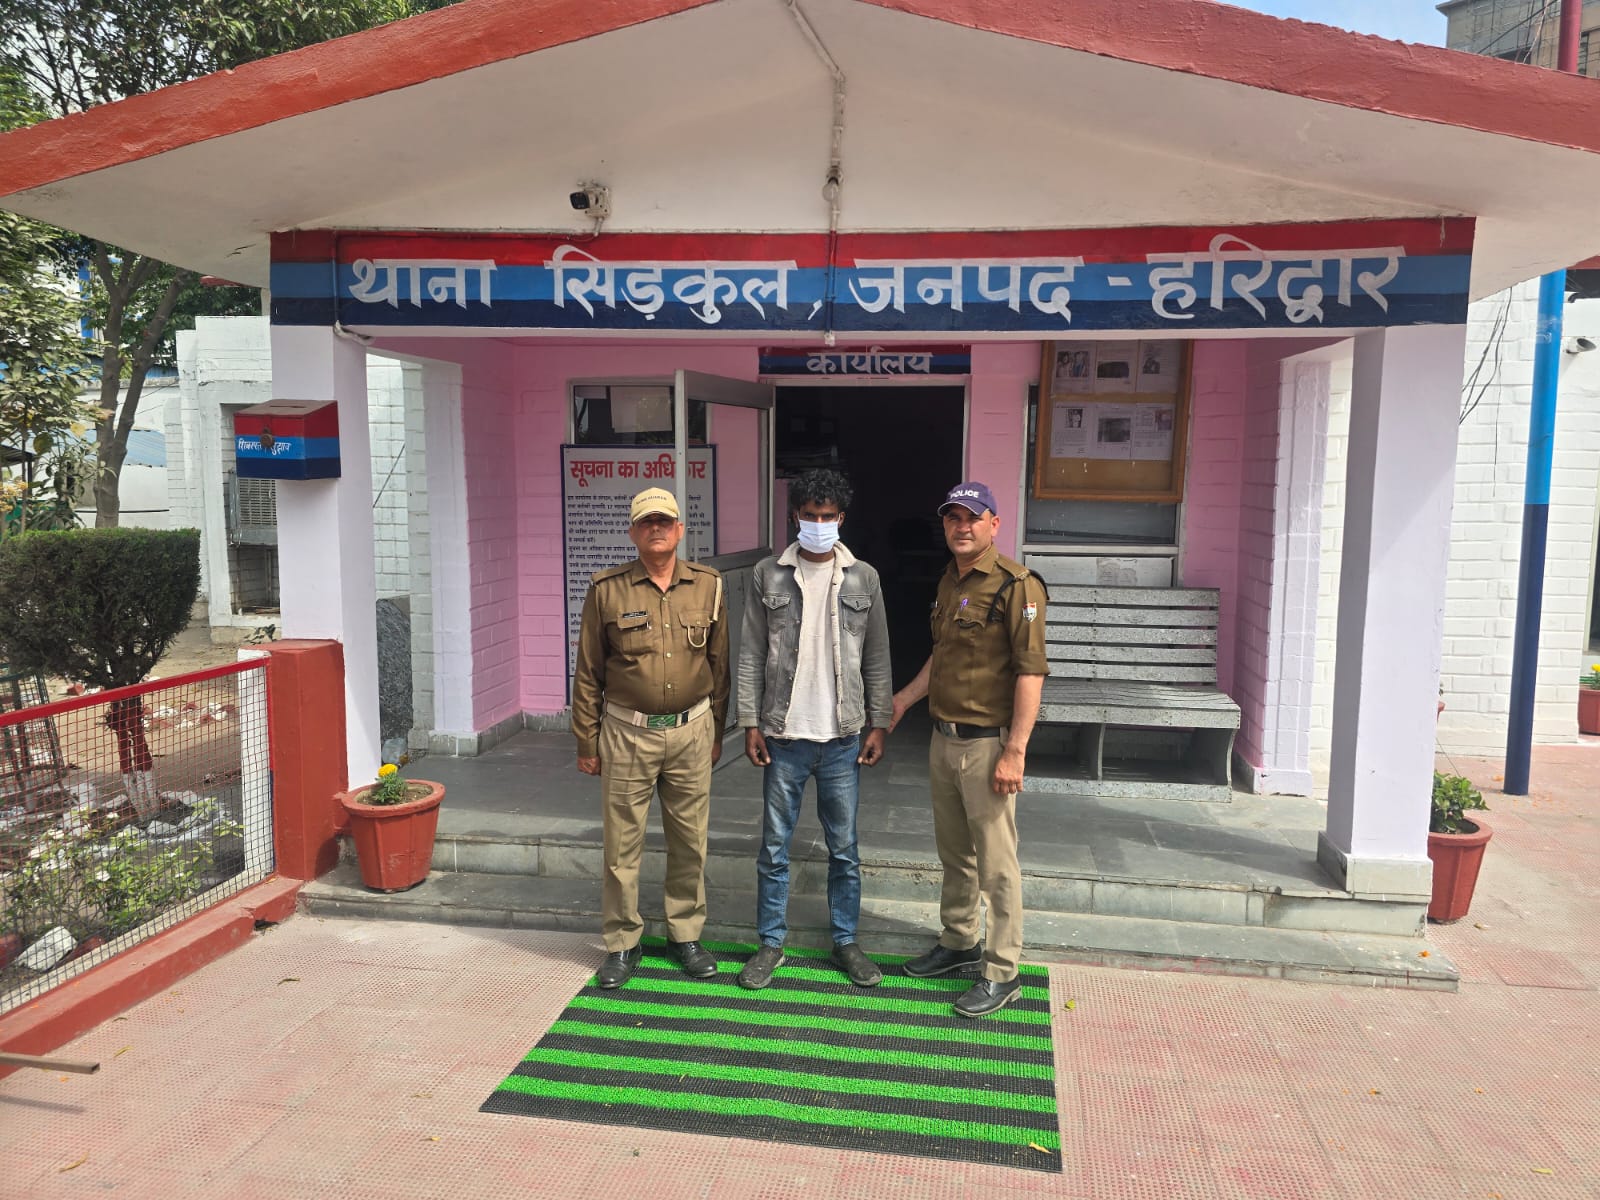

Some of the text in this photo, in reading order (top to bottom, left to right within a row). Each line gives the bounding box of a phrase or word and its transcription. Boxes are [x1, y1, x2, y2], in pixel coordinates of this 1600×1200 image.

[348, 257, 499, 309] थाना
[848, 255, 1085, 324] जनपद
[1145, 233, 1407, 324] हरिद्वार
[806, 346, 933, 375] कार्यालय
[570, 453, 707, 487] सूचना का अधिार
[950, 488, 980, 499] POLICE
